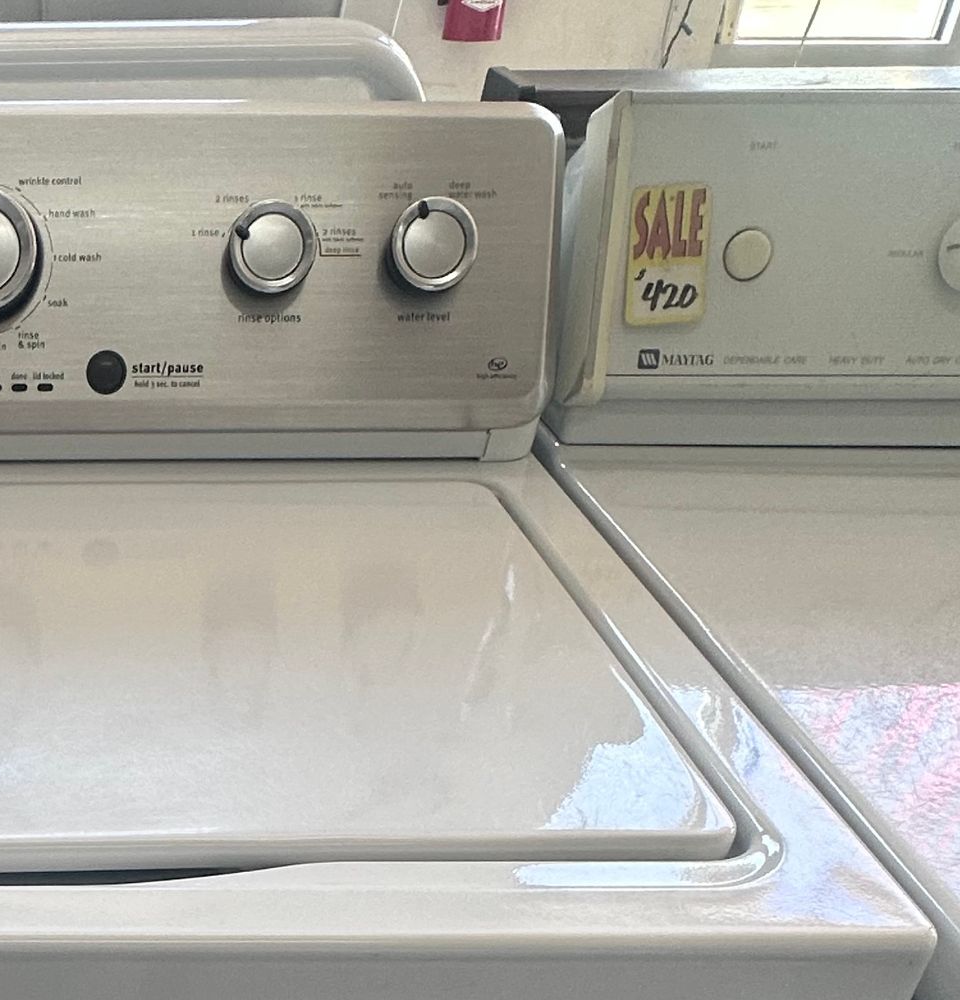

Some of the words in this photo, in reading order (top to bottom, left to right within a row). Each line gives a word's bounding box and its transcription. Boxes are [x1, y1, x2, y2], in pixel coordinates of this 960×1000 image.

[18, 177, 50, 186] wrinkle
[51, 176, 82, 186] control
[393, 181, 413, 190] auto
[449, 180, 471, 191] deep
[222, 194, 250, 203] rinses
[300, 193, 322, 202] rinse
[378, 190, 413, 200] sensing
[474, 189, 498, 199] wash
[48, 208, 70, 218] hand
[71, 208, 96, 218] wash
[633, 188, 706, 260] SALE
[198, 229, 220, 237] rinse
[330, 227, 357, 236] rinses
[58, 252, 77, 262] cold
[78, 252, 102, 262] wash
[47, 298, 69, 307] soak
[237, 313, 263, 323] rinse
[264, 313, 302, 325] options
[397, 313, 425, 322] water
[426, 312, 451, 322] level
[18, 331, 40, 340] rinse
[17, 340, 25, 349] &
[27, 340, 46, 350] spin
[661, 353, 715, 366] MAYTAG
[131, 361, 204, 377] start/pause
